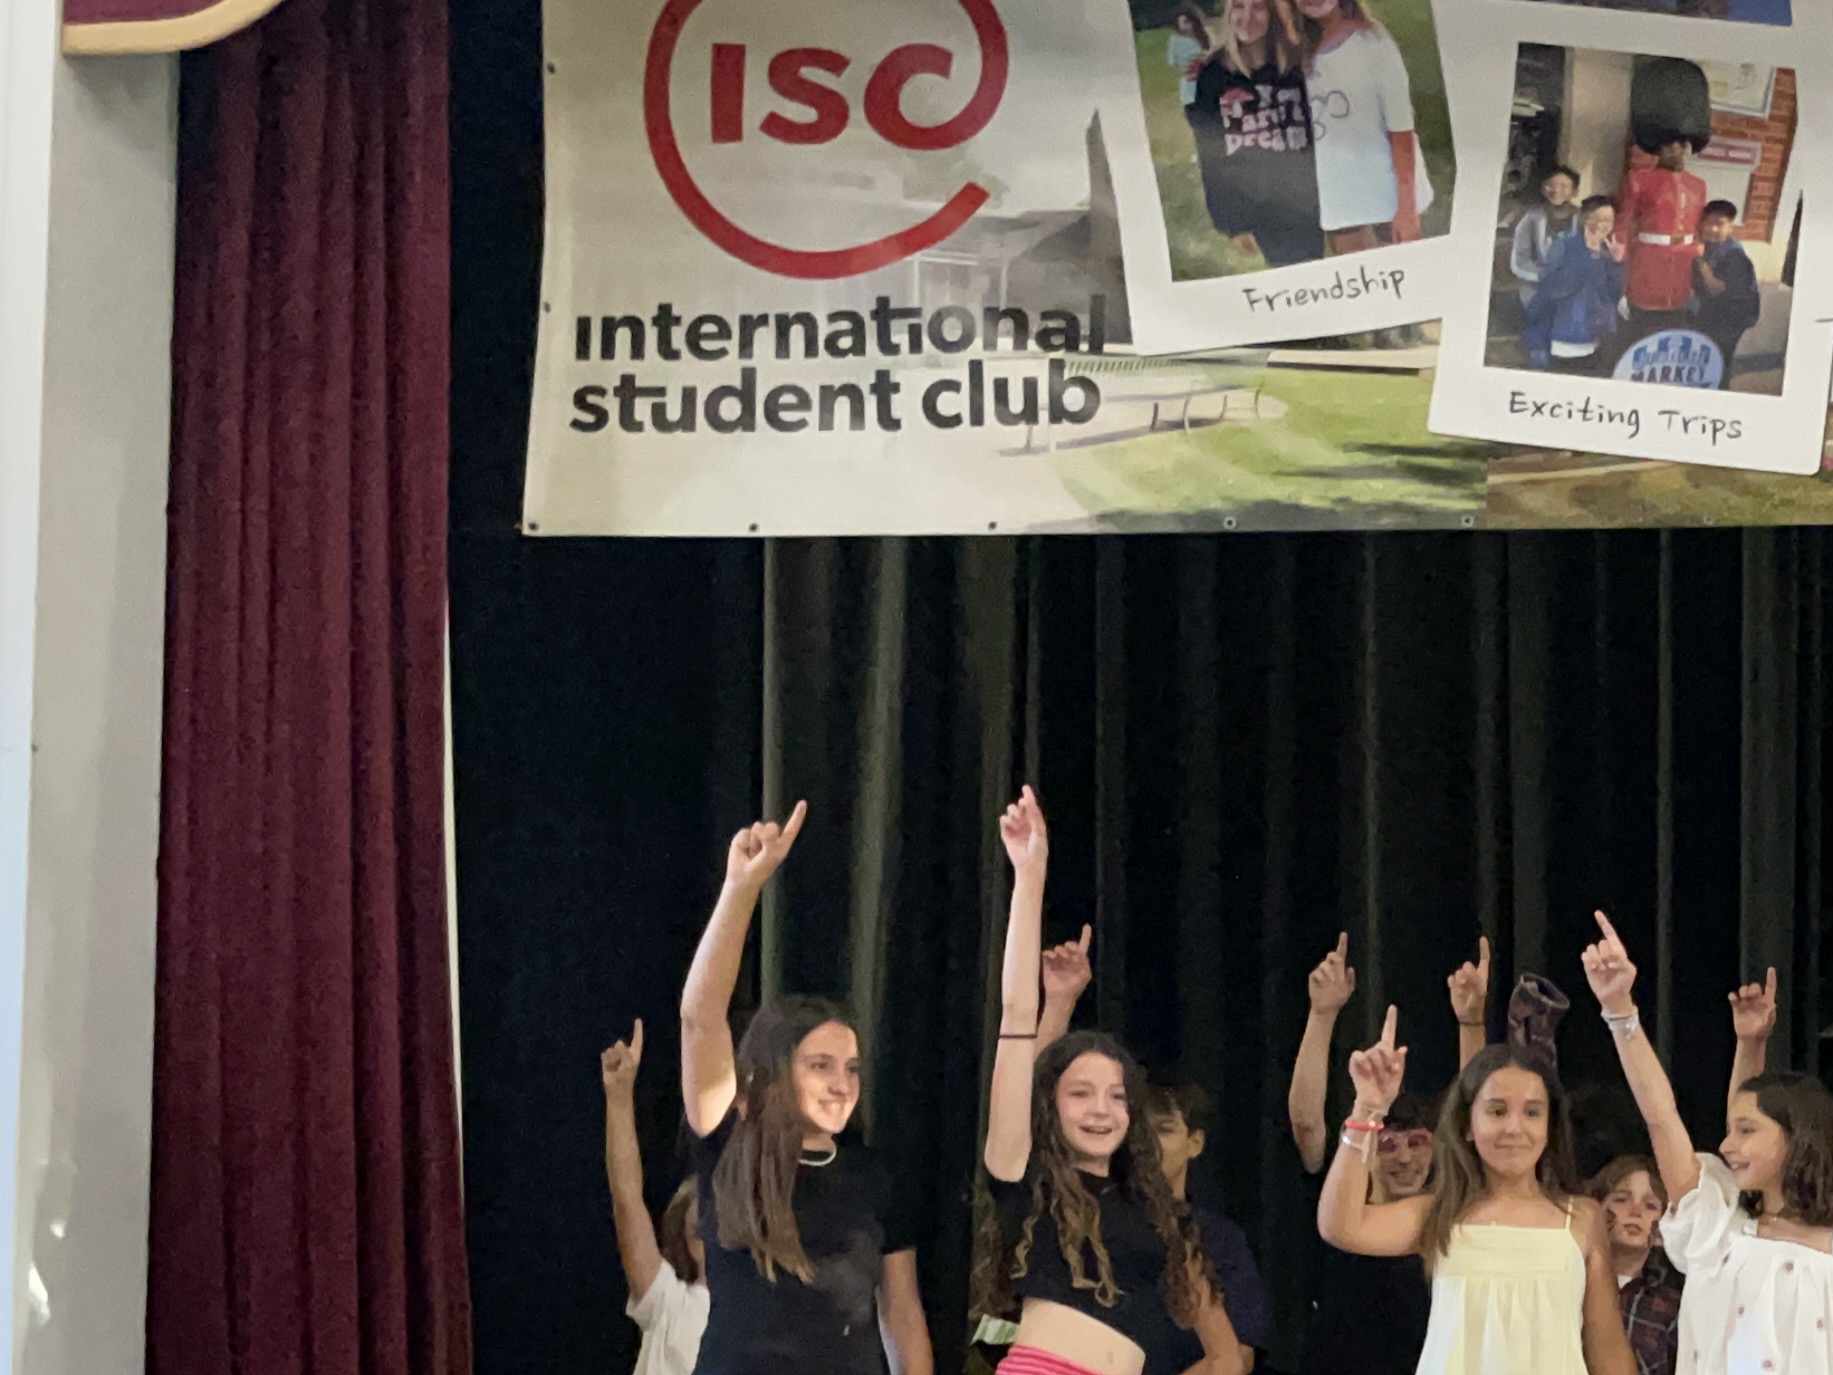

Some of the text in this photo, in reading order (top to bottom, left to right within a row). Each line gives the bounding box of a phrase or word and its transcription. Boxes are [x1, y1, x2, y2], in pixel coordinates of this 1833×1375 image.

[1242, 265, 1405, 313] Friendship
[574, 294, 1106, 361] international
[569, 359, 1102, 433] student club
[1509, 391, 1744, 447] Exciting Trips
